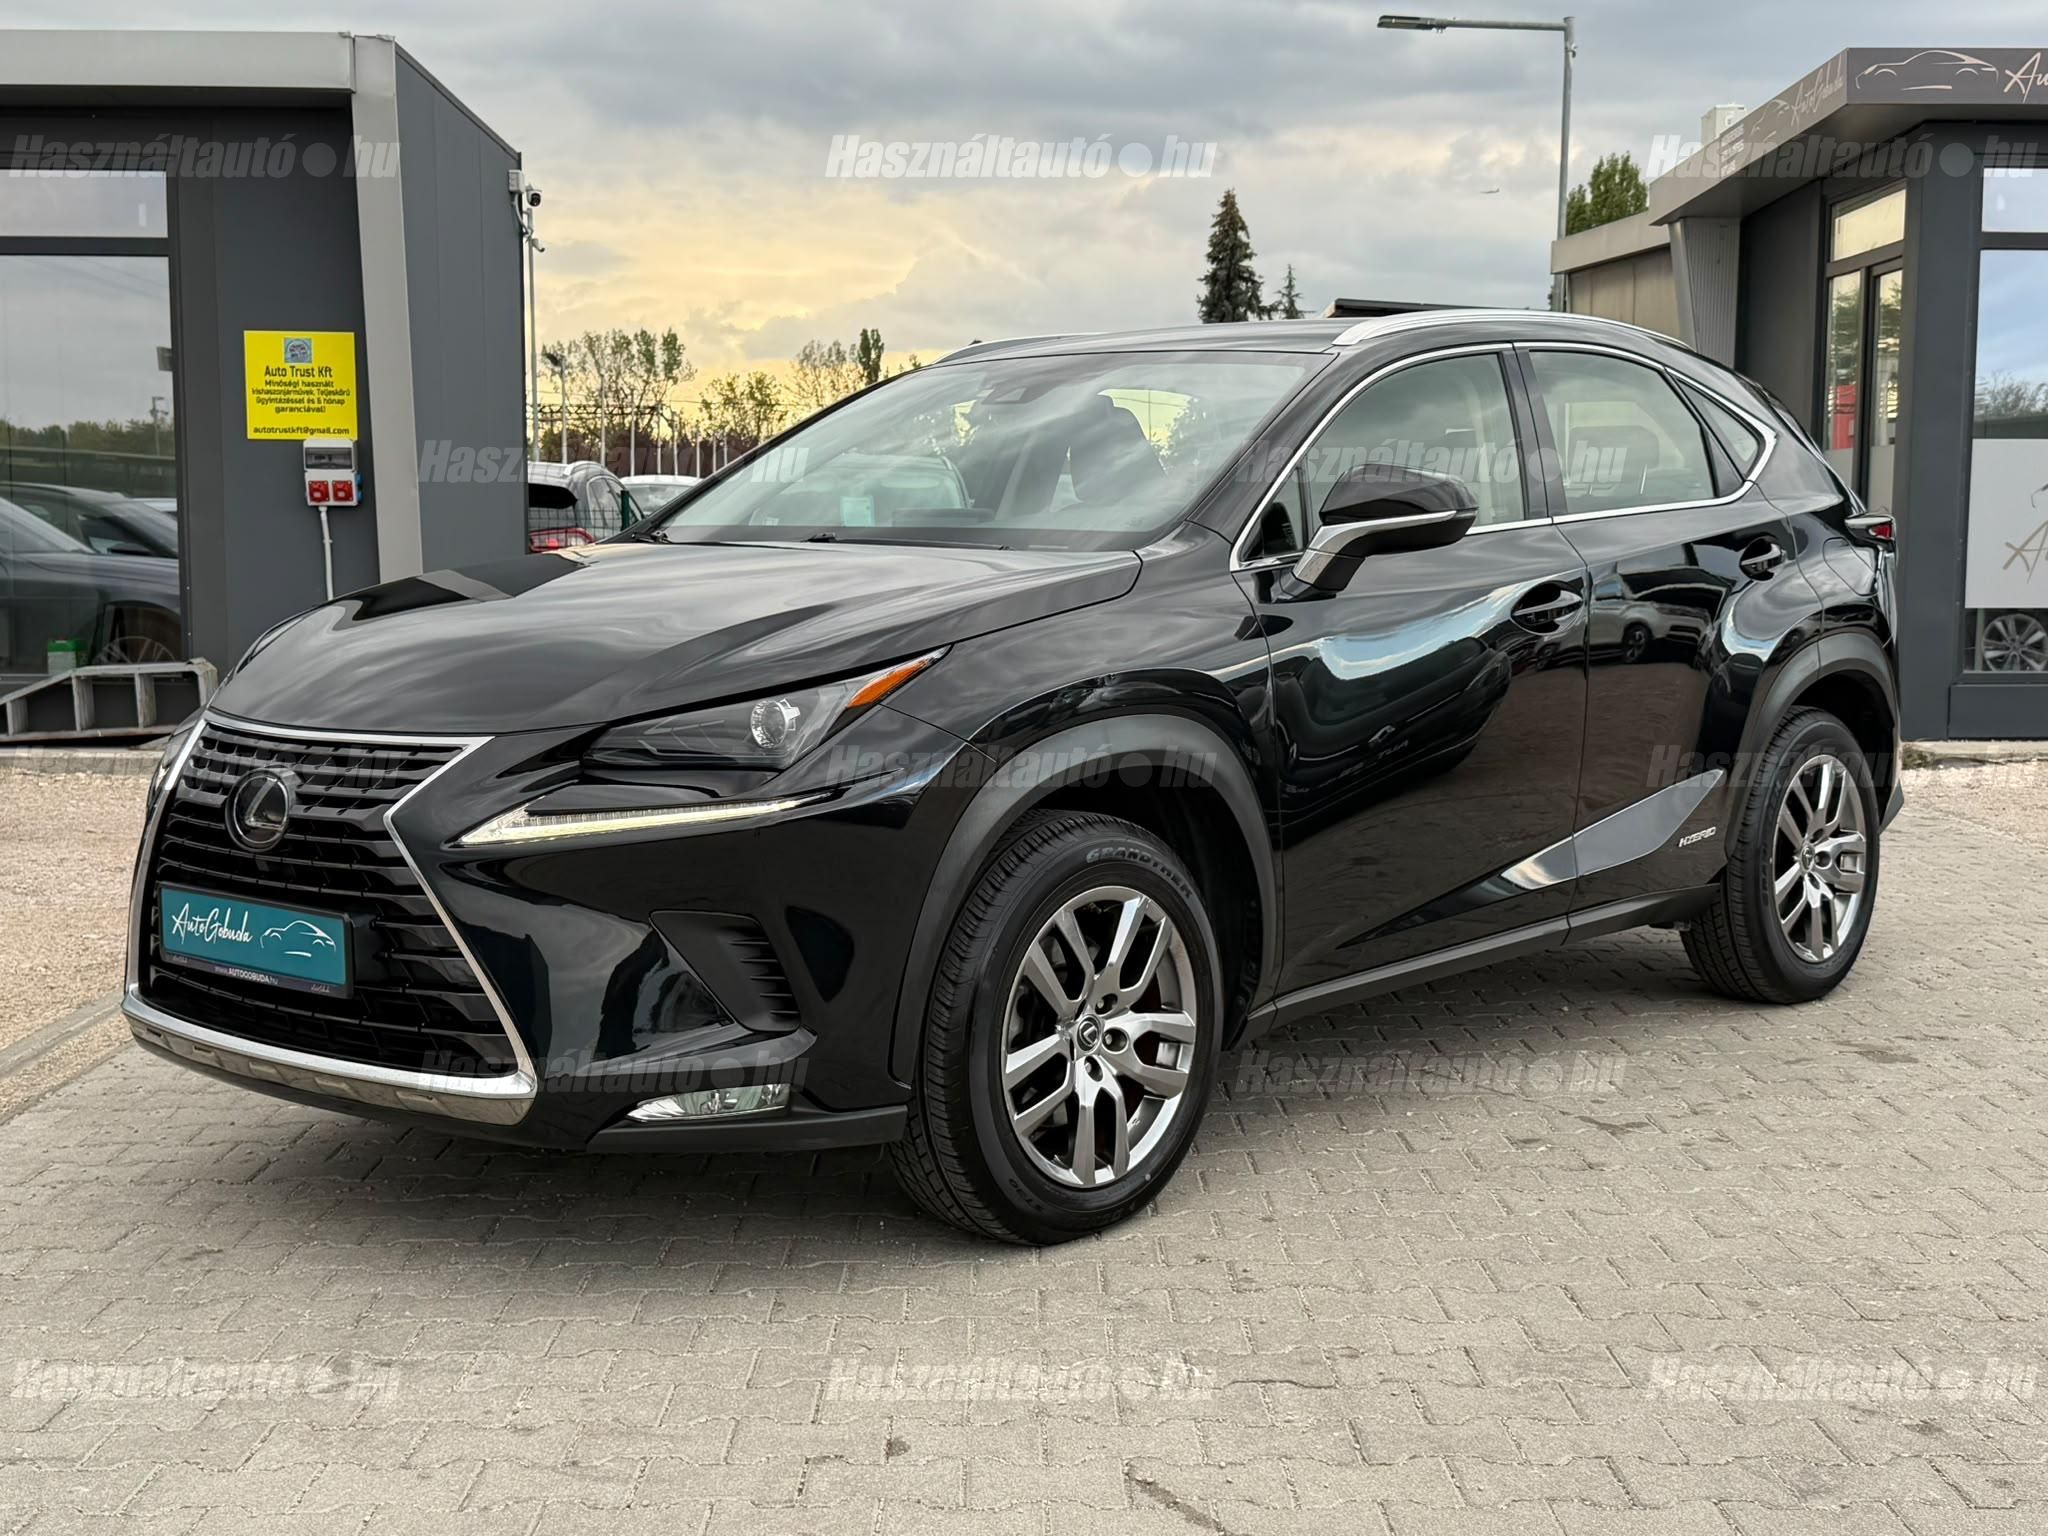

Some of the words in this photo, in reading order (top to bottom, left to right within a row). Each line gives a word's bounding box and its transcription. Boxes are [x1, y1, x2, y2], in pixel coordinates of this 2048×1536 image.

[264, 365, 287, 377] Auto
[289, 365, 315, 378] Trust
[318, 365, 333, 378] Kft
[253, 426, 350, 436] autotrustkft@gmail.com
